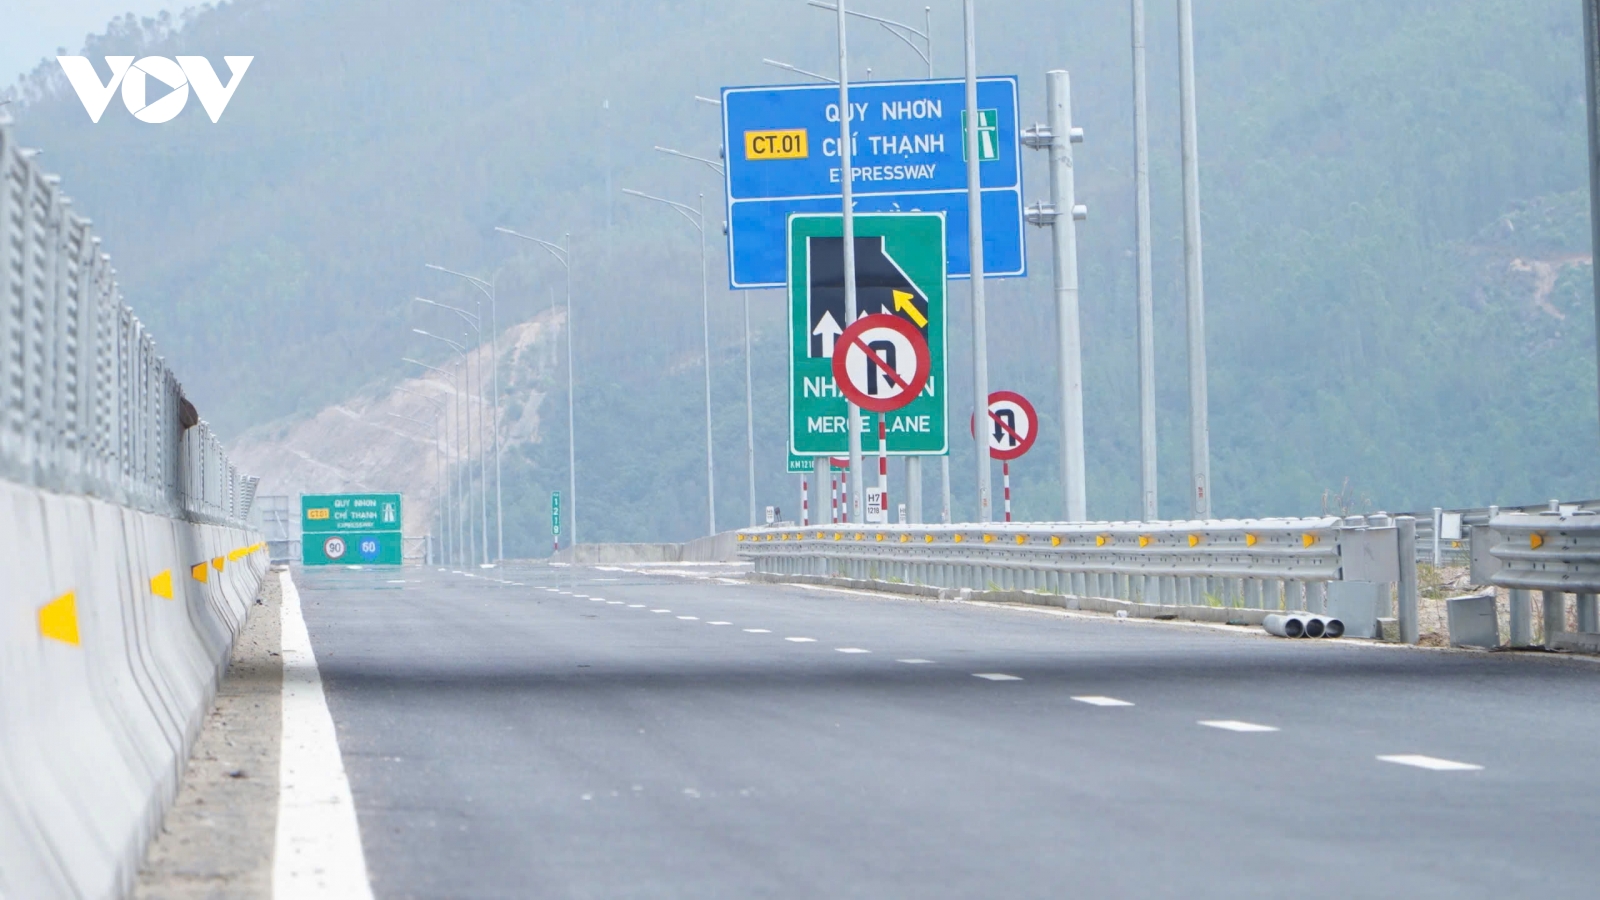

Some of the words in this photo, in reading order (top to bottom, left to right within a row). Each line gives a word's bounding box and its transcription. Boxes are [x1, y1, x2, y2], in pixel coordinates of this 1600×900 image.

[882, 98, 942, 121] NHƠN
[752, 134, 801, 154] CT.01
[869, 134, 945, 159] THẠNH
[829, 164, 936, 183] EPRESSWAY
[807, 416, 871, 433] MERE
[868, 494, 880, 502] H7
[329, 542, 341, 553] 90
[362, 541, 376, 553] 60
